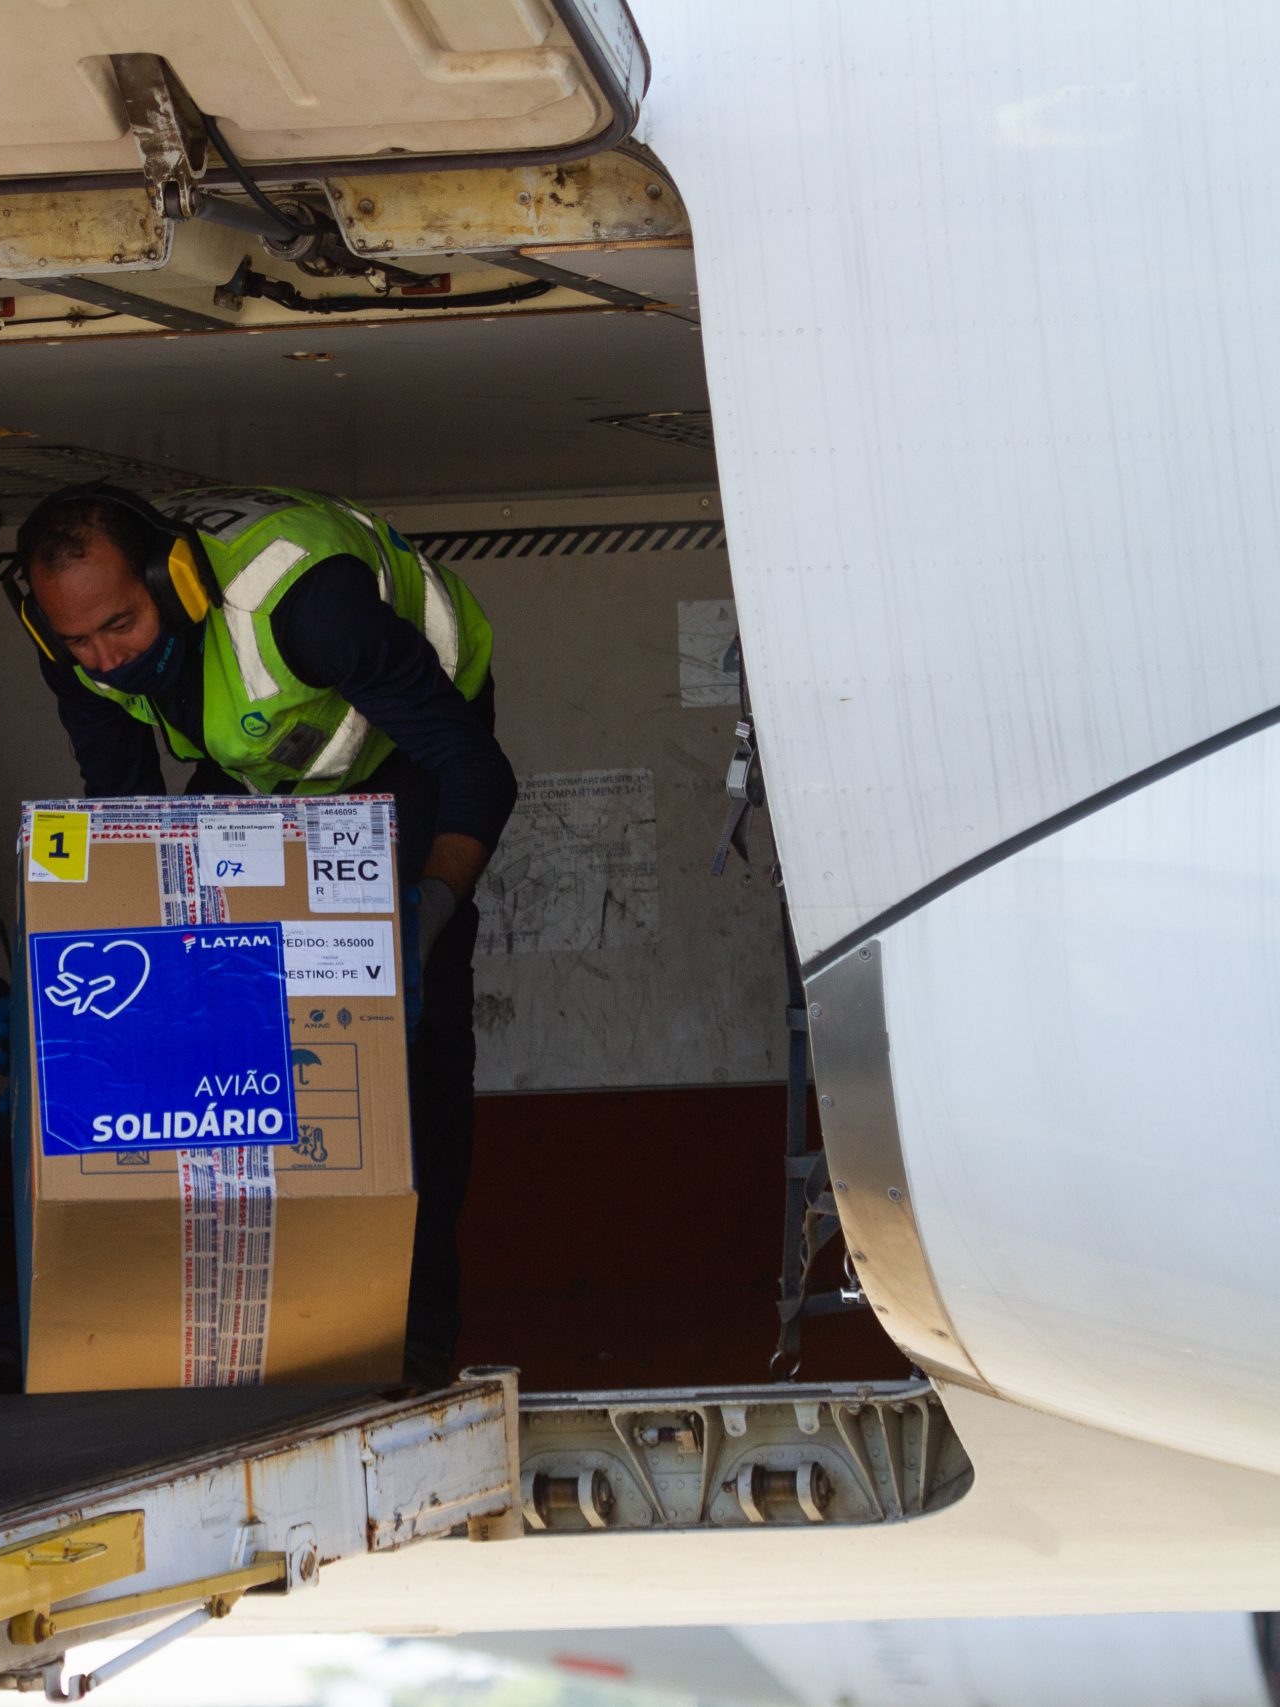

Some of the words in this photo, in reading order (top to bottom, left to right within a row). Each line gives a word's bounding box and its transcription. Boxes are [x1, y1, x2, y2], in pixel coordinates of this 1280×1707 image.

[48, 831, 70, 859] 1
[333, 832, 360, 845] PV
[216, 860, 245, 878] 07
[313, 859, 380, 881] REC
[316, 886, 324, 895] R
[201, 935, 271, 949] LATAM
[332, 938, 374, 948] 365000
[342, 969, 359, 979] PE
[366, 965, 382, 980] V
[194, 1069, 281, 1097] AVIÃO
[92, 1102, 283, 1142] SOLIDÁRIO
